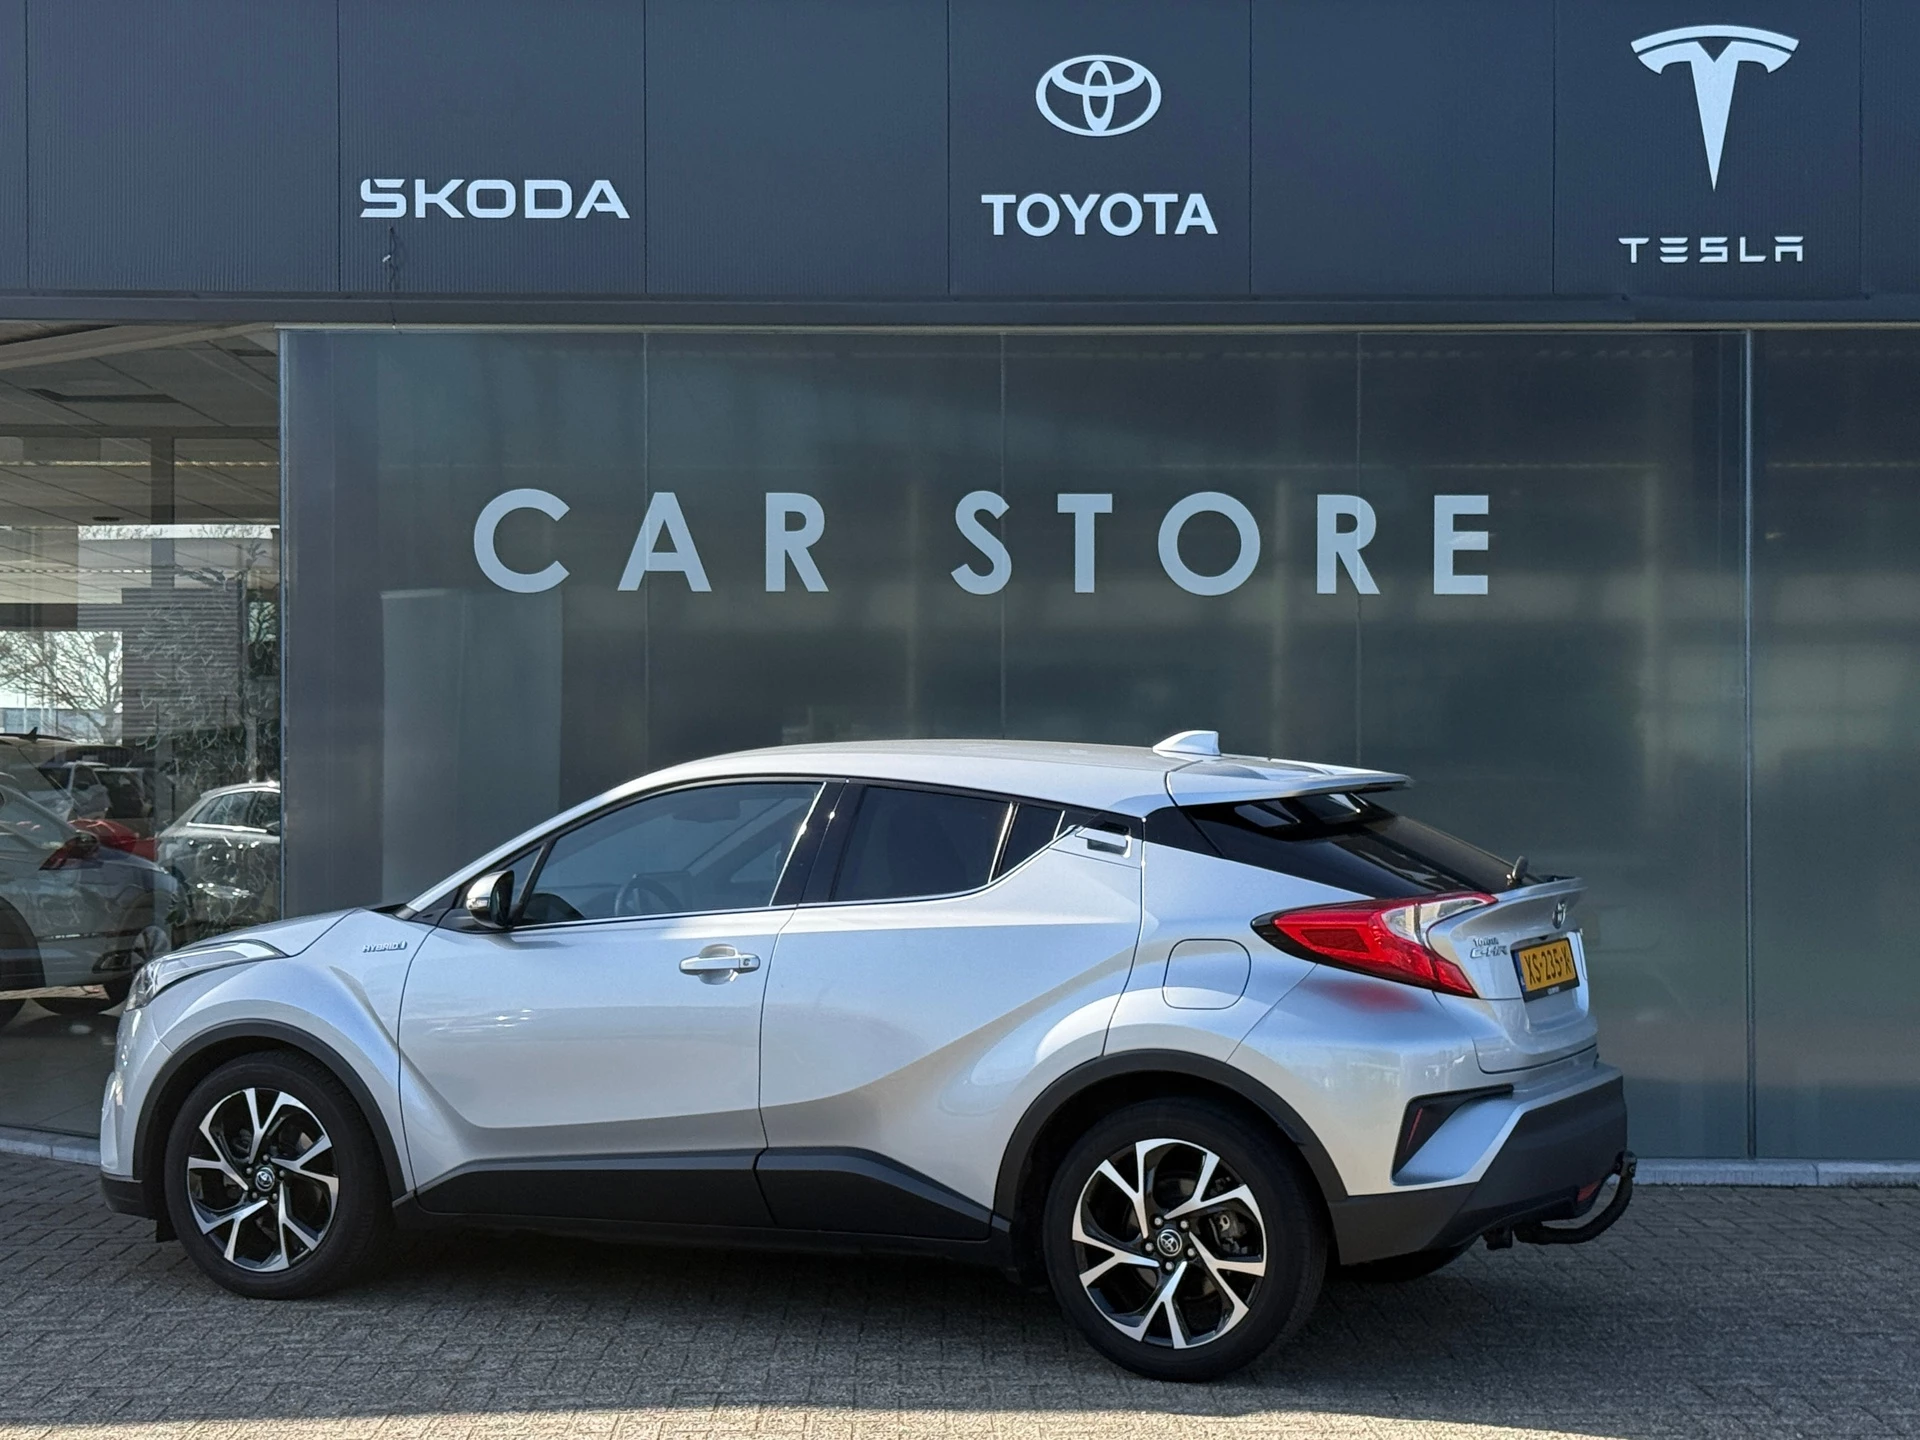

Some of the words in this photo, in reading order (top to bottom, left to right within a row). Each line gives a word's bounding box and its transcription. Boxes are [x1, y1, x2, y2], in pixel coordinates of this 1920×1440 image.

[360, 178, 630, 220] SKODA
[981, 192, 1218, 237] TOYOTA
[1618, 236, 1805, 264] TESLA
[473, 488, 830, 593] CAR
[951, 490, 1490, 596] STORE
